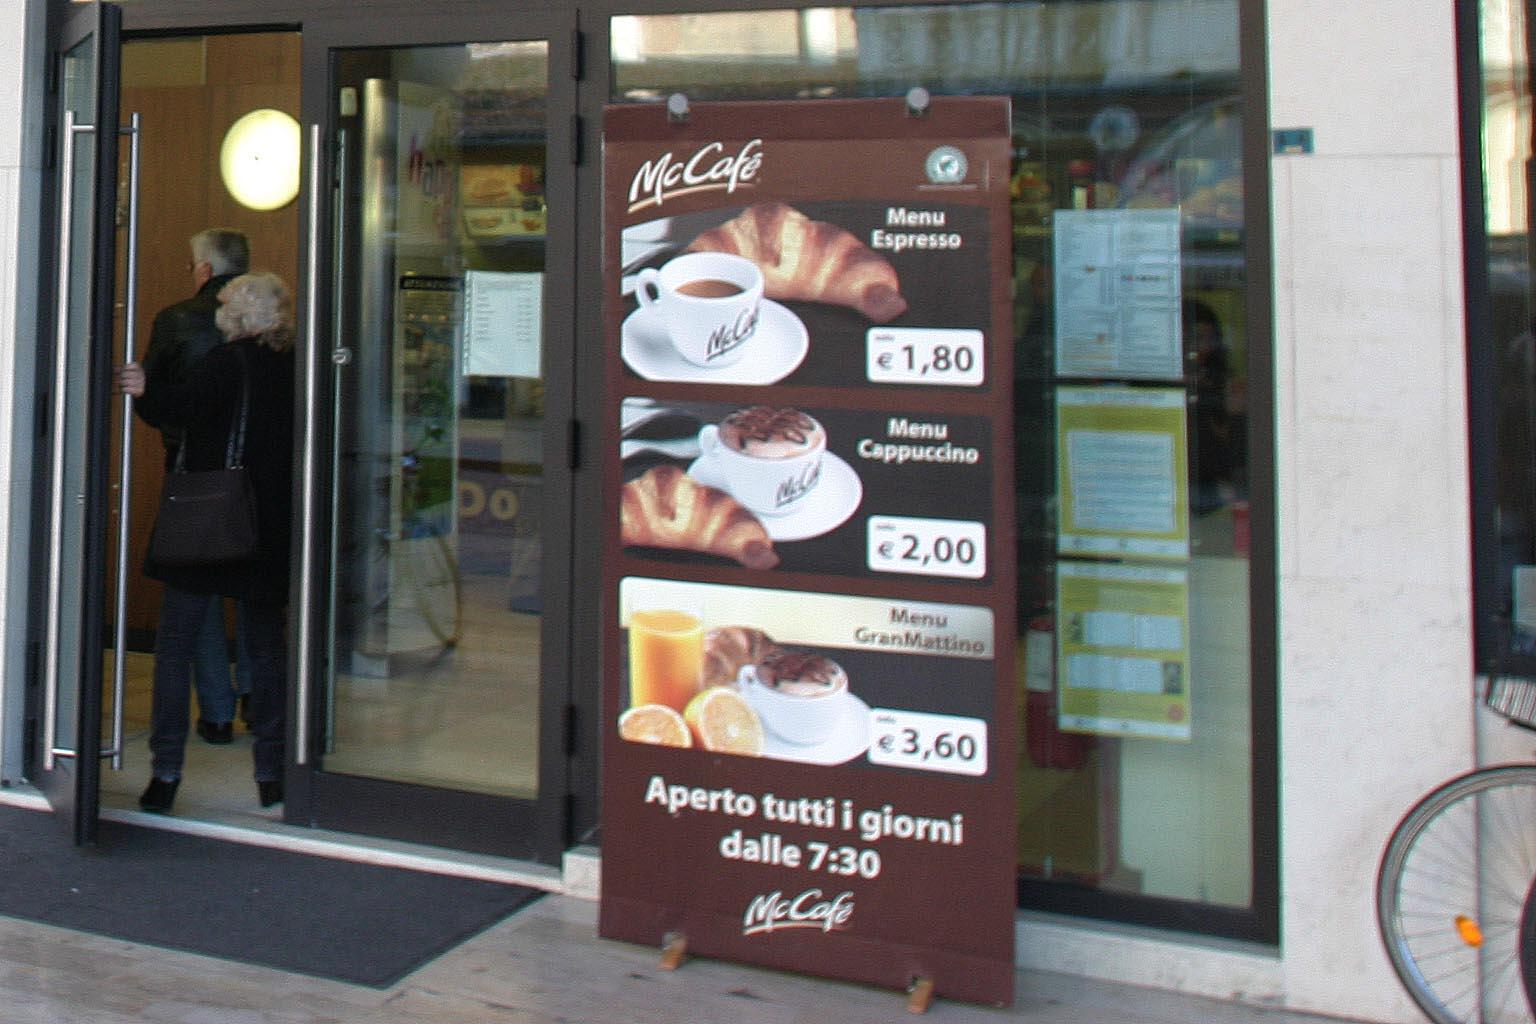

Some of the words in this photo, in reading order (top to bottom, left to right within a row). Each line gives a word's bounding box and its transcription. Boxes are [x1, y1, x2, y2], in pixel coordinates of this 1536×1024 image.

[627, 139, 764, 213] McCafé
[886, 207, 945, 227] Menu
[872, 229, 963, 252] Espresso
[888, 418, 948, 439] Menu
[857, 438, 979, 464] Cappuccino
[890, 606, 949, 627] Menu
[854, 626, 986, 655] GranMattino
[644, 774, 757, 818] Aperto
[763, 793, 836, 828] tutti
[842, 799, 854, 830] i
[859, 806, 964, 846] giorni
[719, 830, 801, 868] dalle
[809, 843, 881, 879] 7:30
[743, 888, 855, 936] McCafé
